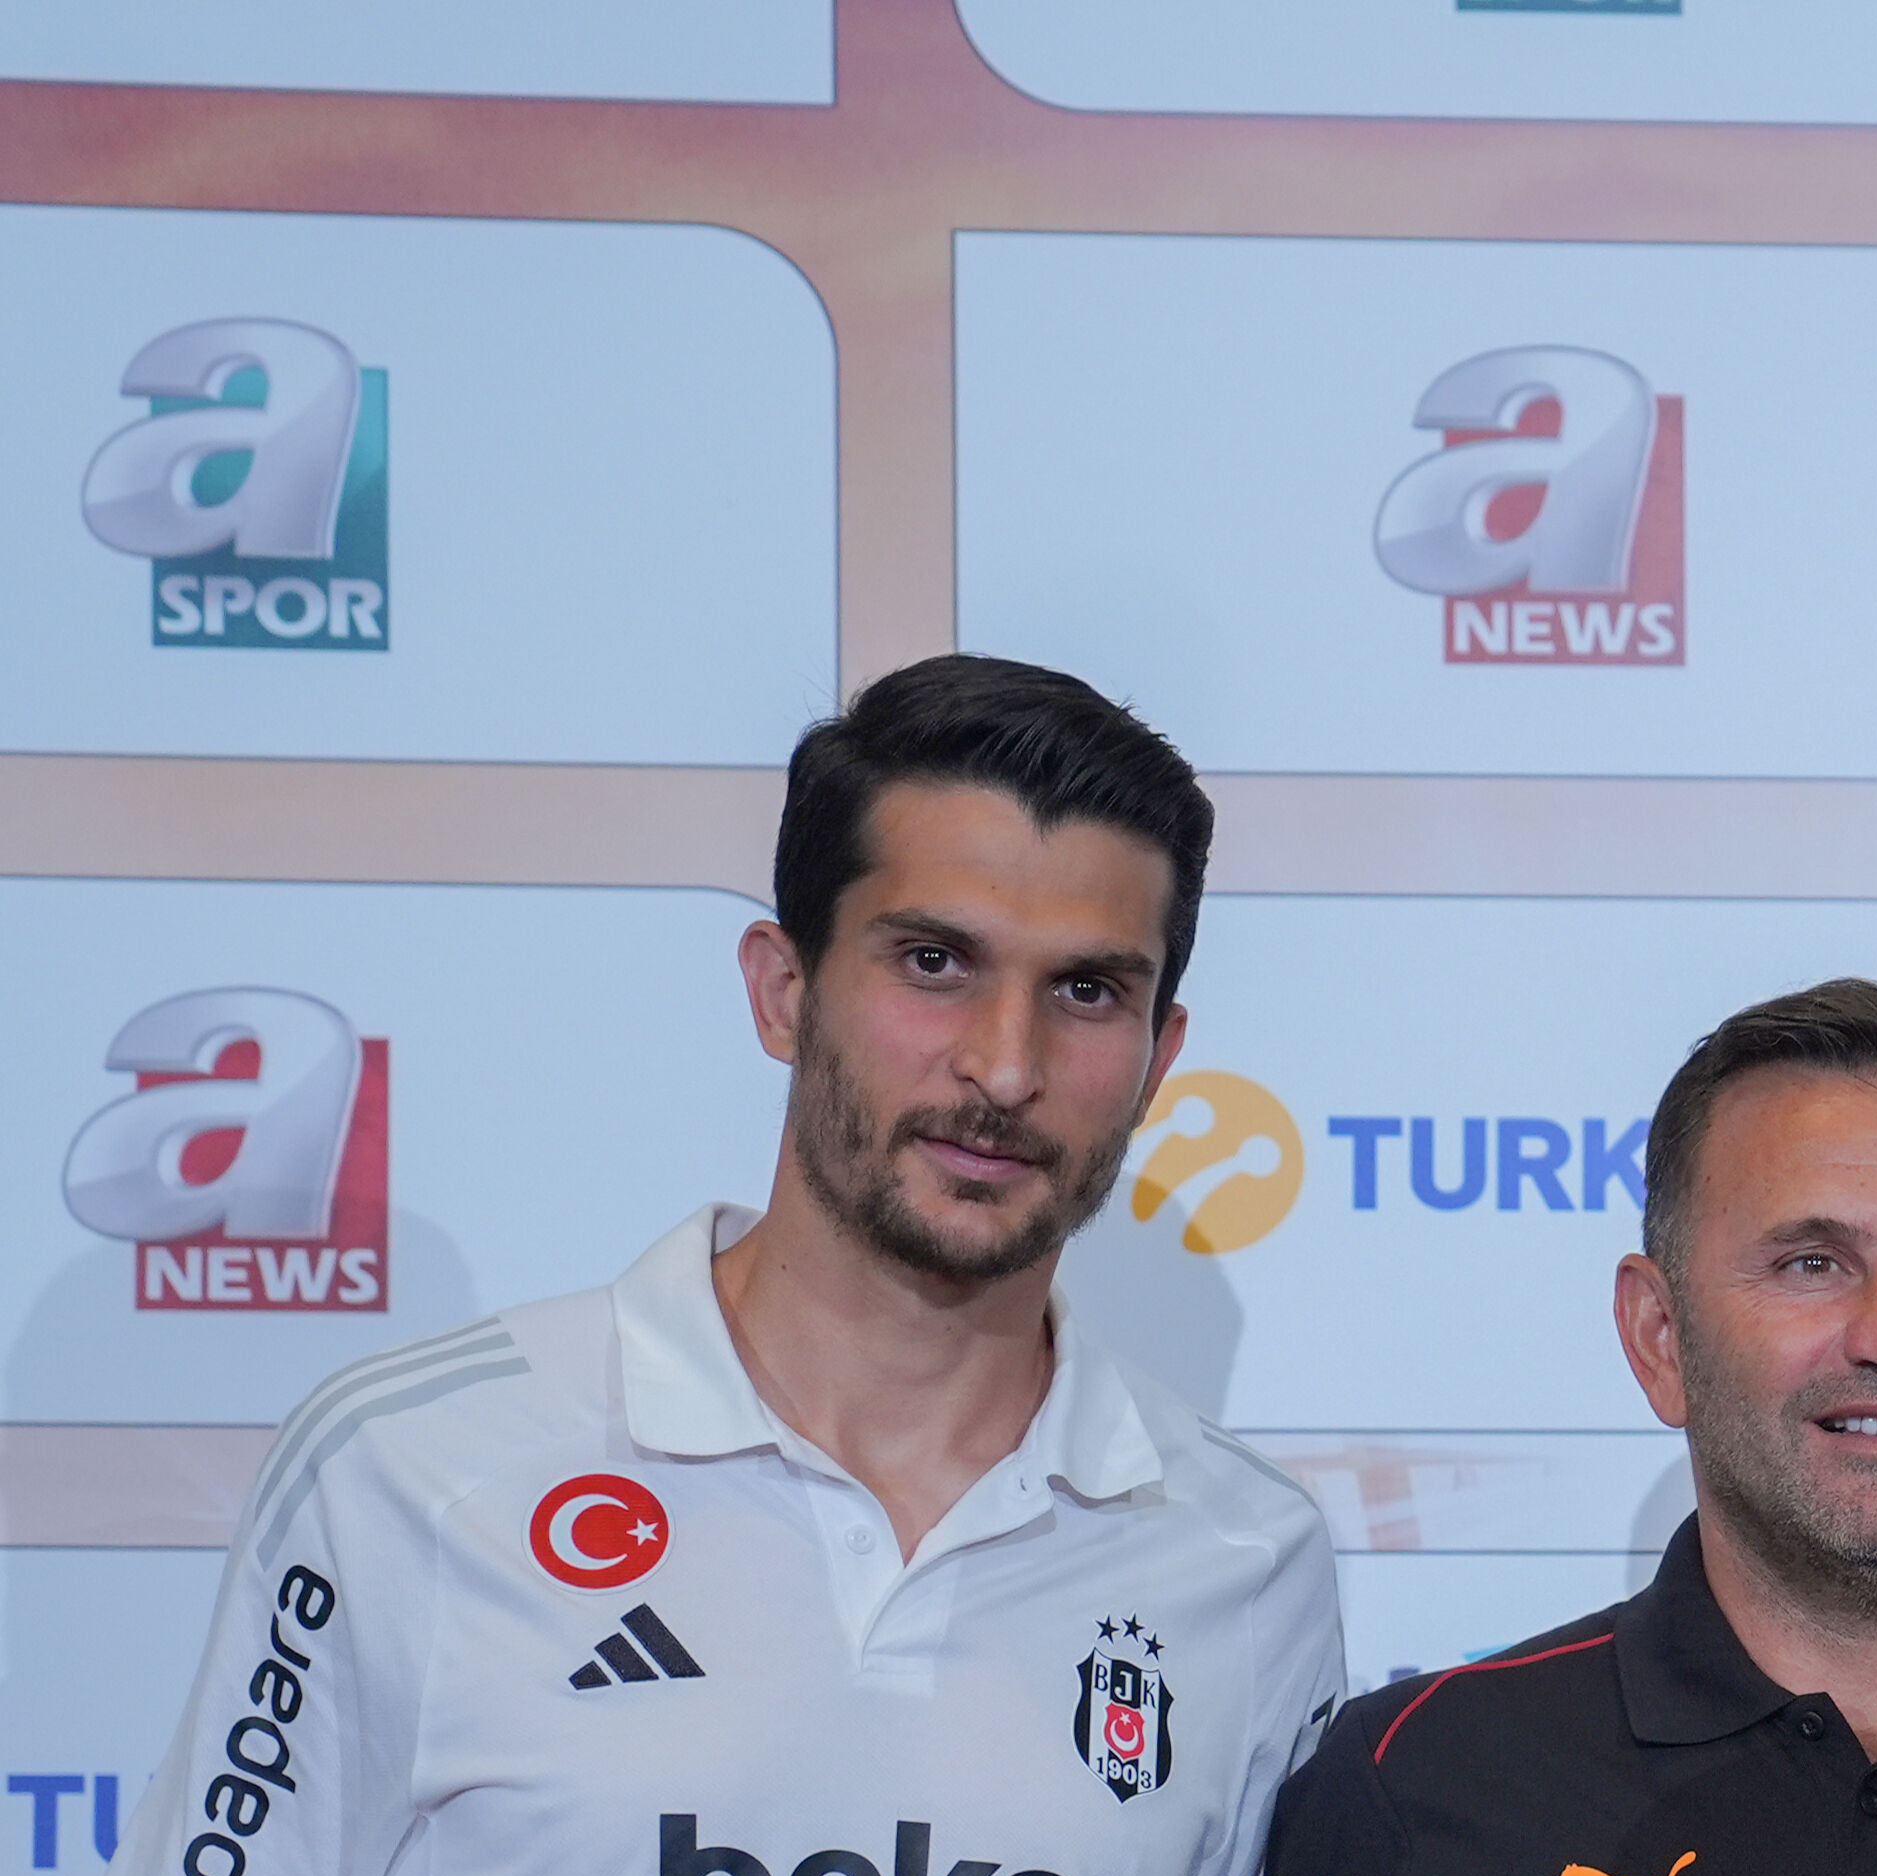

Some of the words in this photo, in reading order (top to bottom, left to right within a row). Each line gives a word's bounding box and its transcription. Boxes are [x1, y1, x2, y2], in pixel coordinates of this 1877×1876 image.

[157, 576, 383, 639] SPOR
[1453, 601, 1676, 656] NEWS
[143, 1246, 380, 1305] NEWS
[1094, 1663, 1156, 1710] BJK
[1096, 1756, 1153, 1789] 1903
